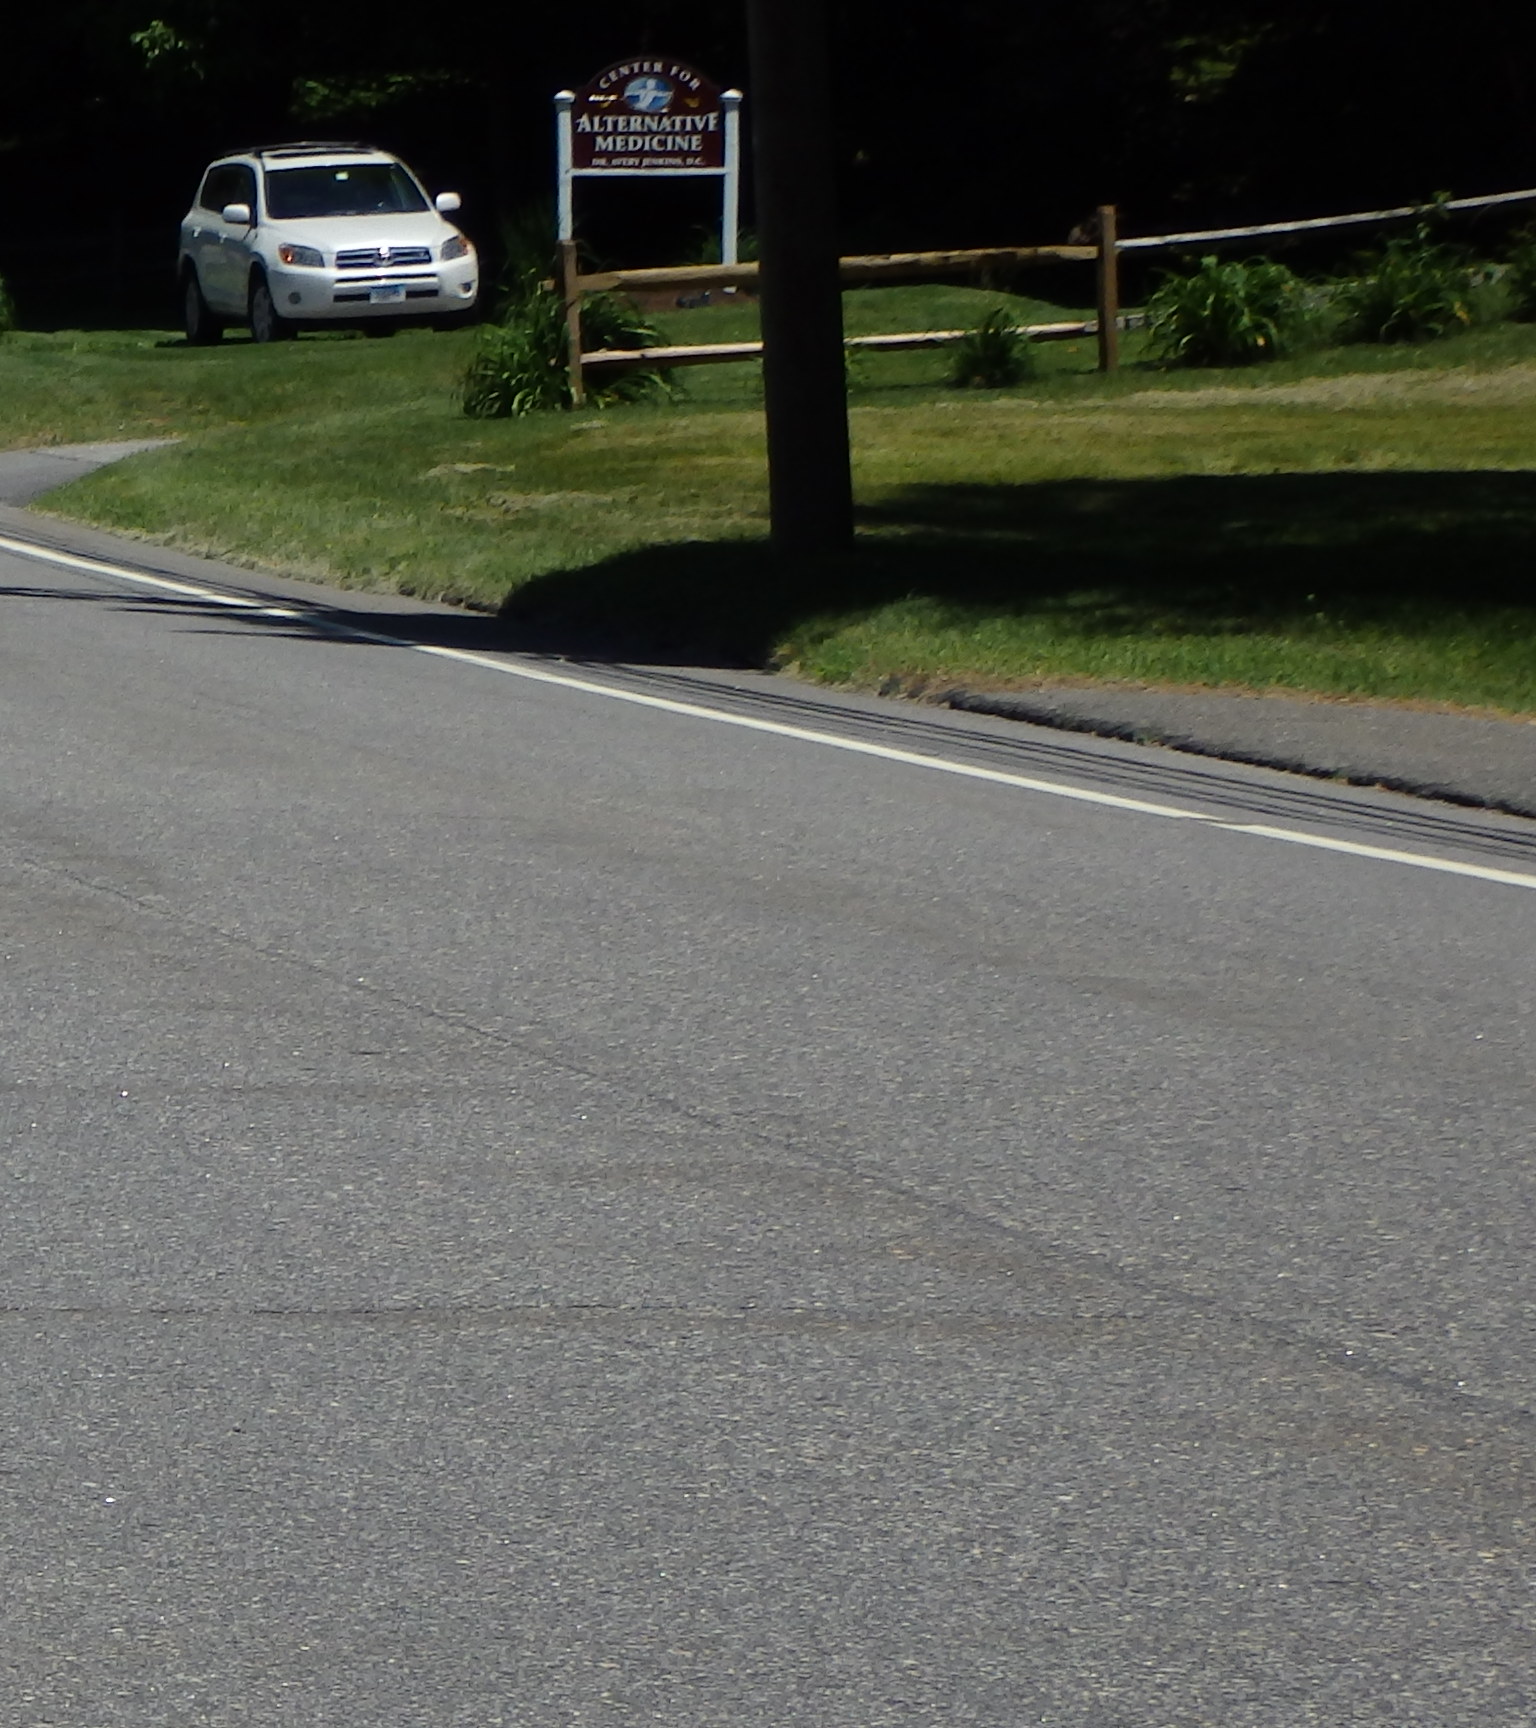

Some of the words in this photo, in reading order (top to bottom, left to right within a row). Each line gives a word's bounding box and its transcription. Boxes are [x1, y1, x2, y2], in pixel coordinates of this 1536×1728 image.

[599, 62, 662, 88] CENTER
[670, 66, 701, 90] FOR
[576, 111, 719, 132] ALTERNATIVE
[595, 135, 702, 152] MEDICINE
